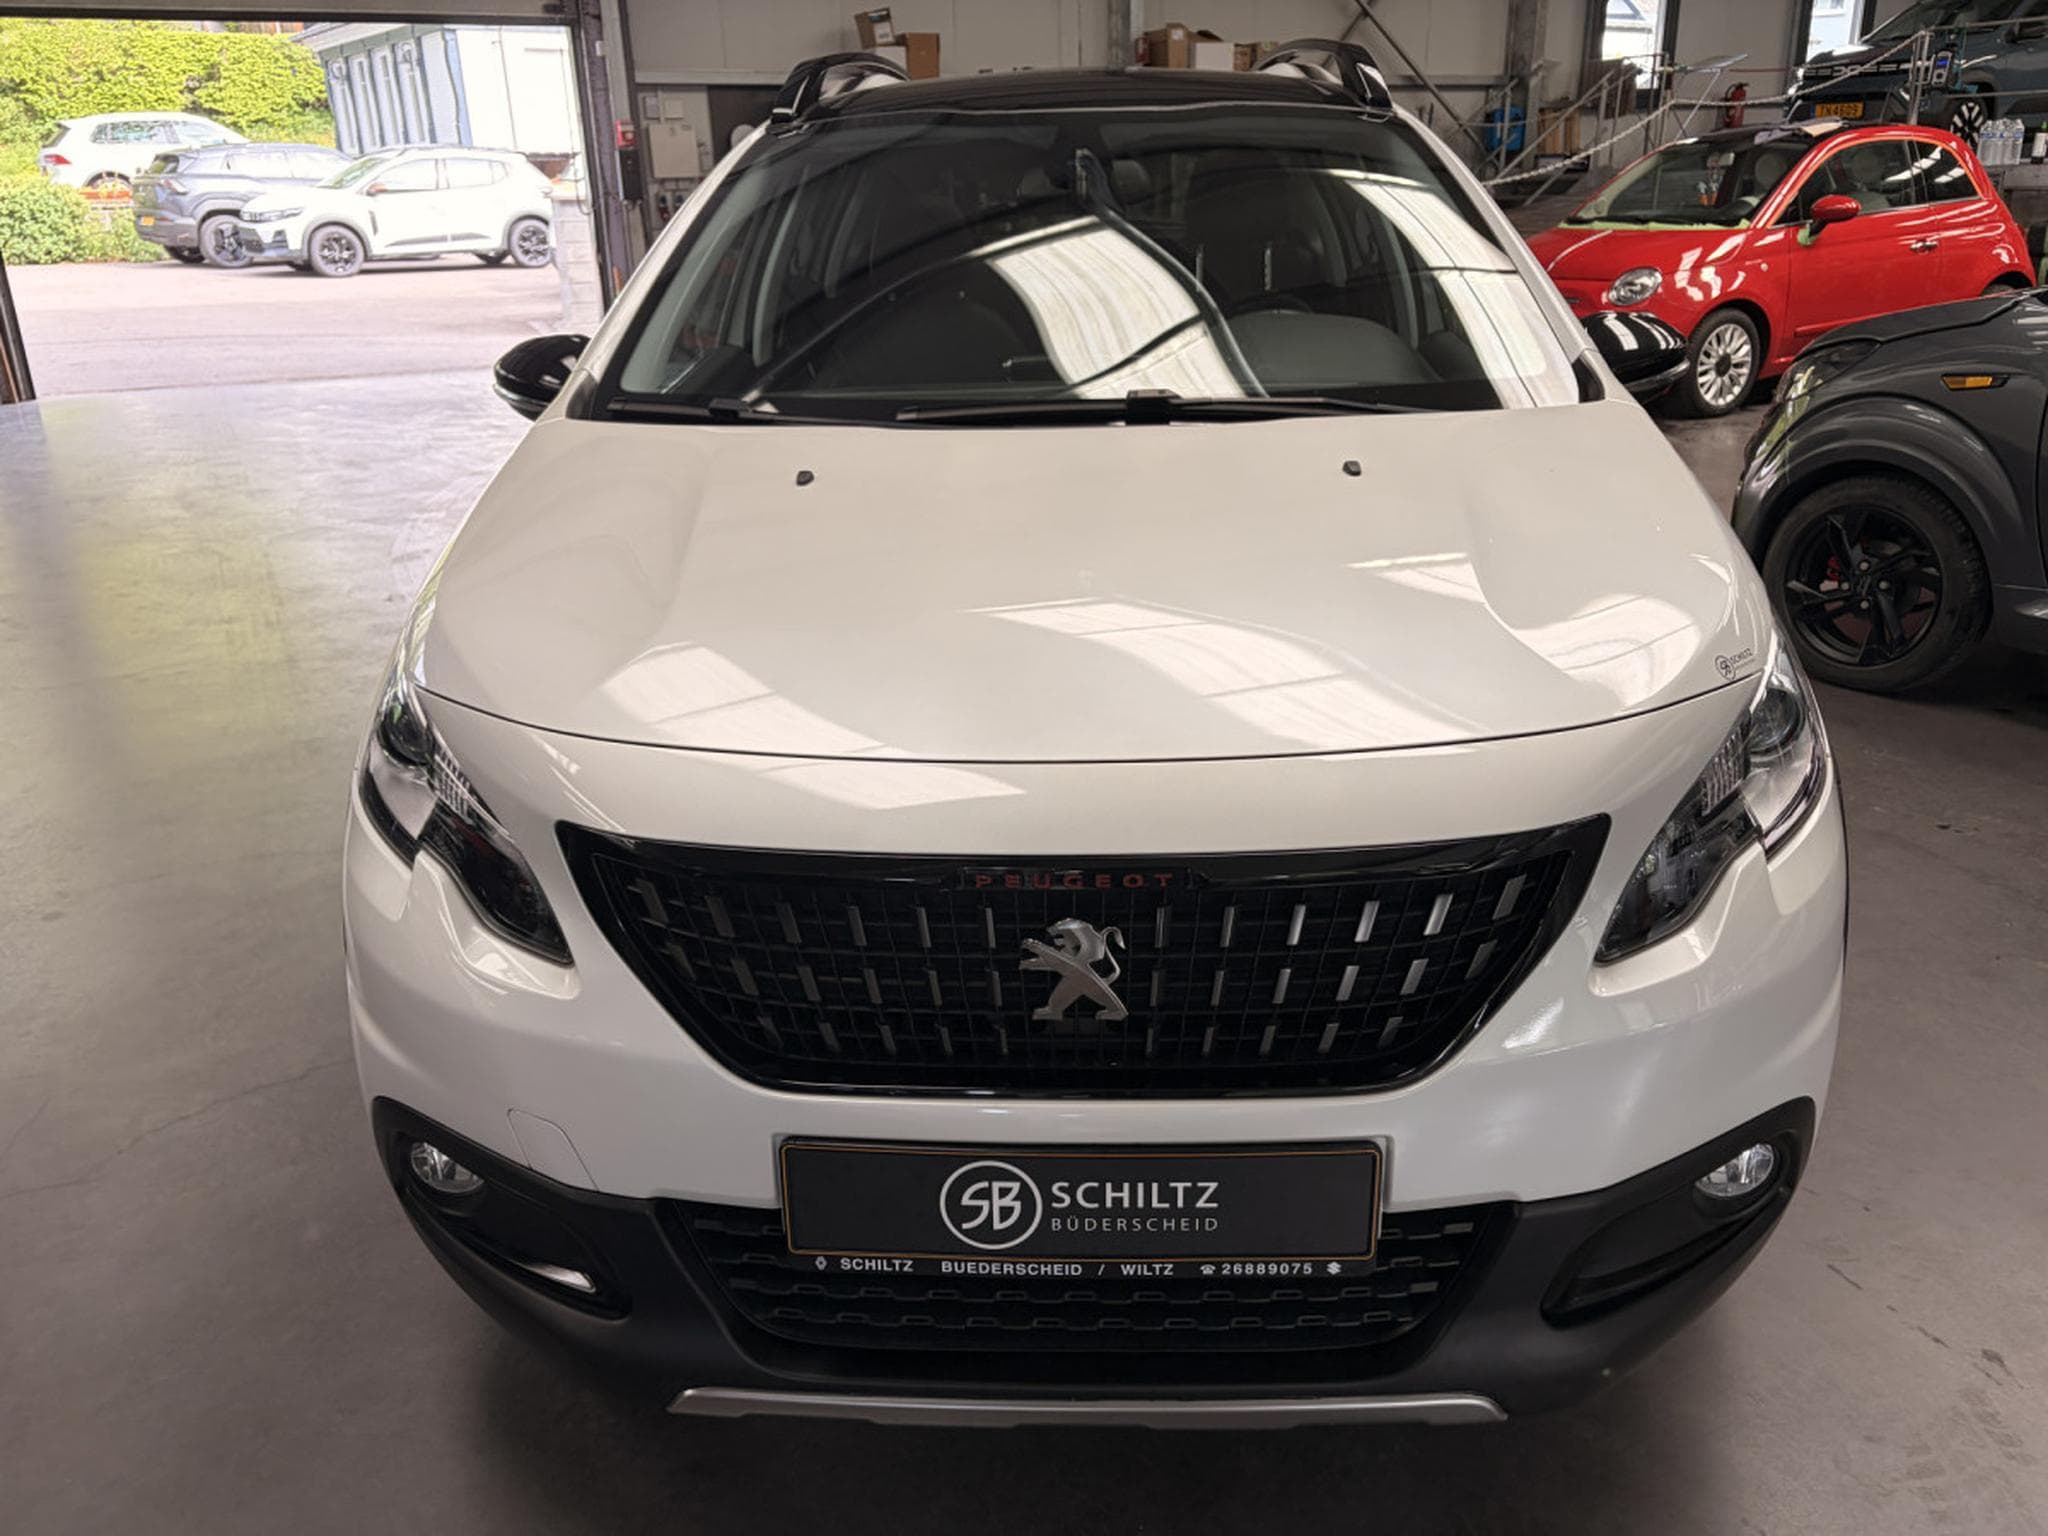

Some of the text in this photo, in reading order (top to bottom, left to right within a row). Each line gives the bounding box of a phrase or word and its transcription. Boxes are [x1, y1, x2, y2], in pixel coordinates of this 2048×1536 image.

[975, 873, 1173, 889] PEUGEOT
[1051, 1181, 1219, 1209] SCHILTZ
[960, 1180, 1022, 1231] SB
[1051, 1215, 1219, 1232] BÜDERSCHEID
[840, 1257, 914, 1272] SCHILTZ
[941, 1260, 1083, 1276] BUEDERSCHEID
[1120, 1263, 1175, 1276] WILTZ
[1221, 1262, 1313, 1275] 26889075
